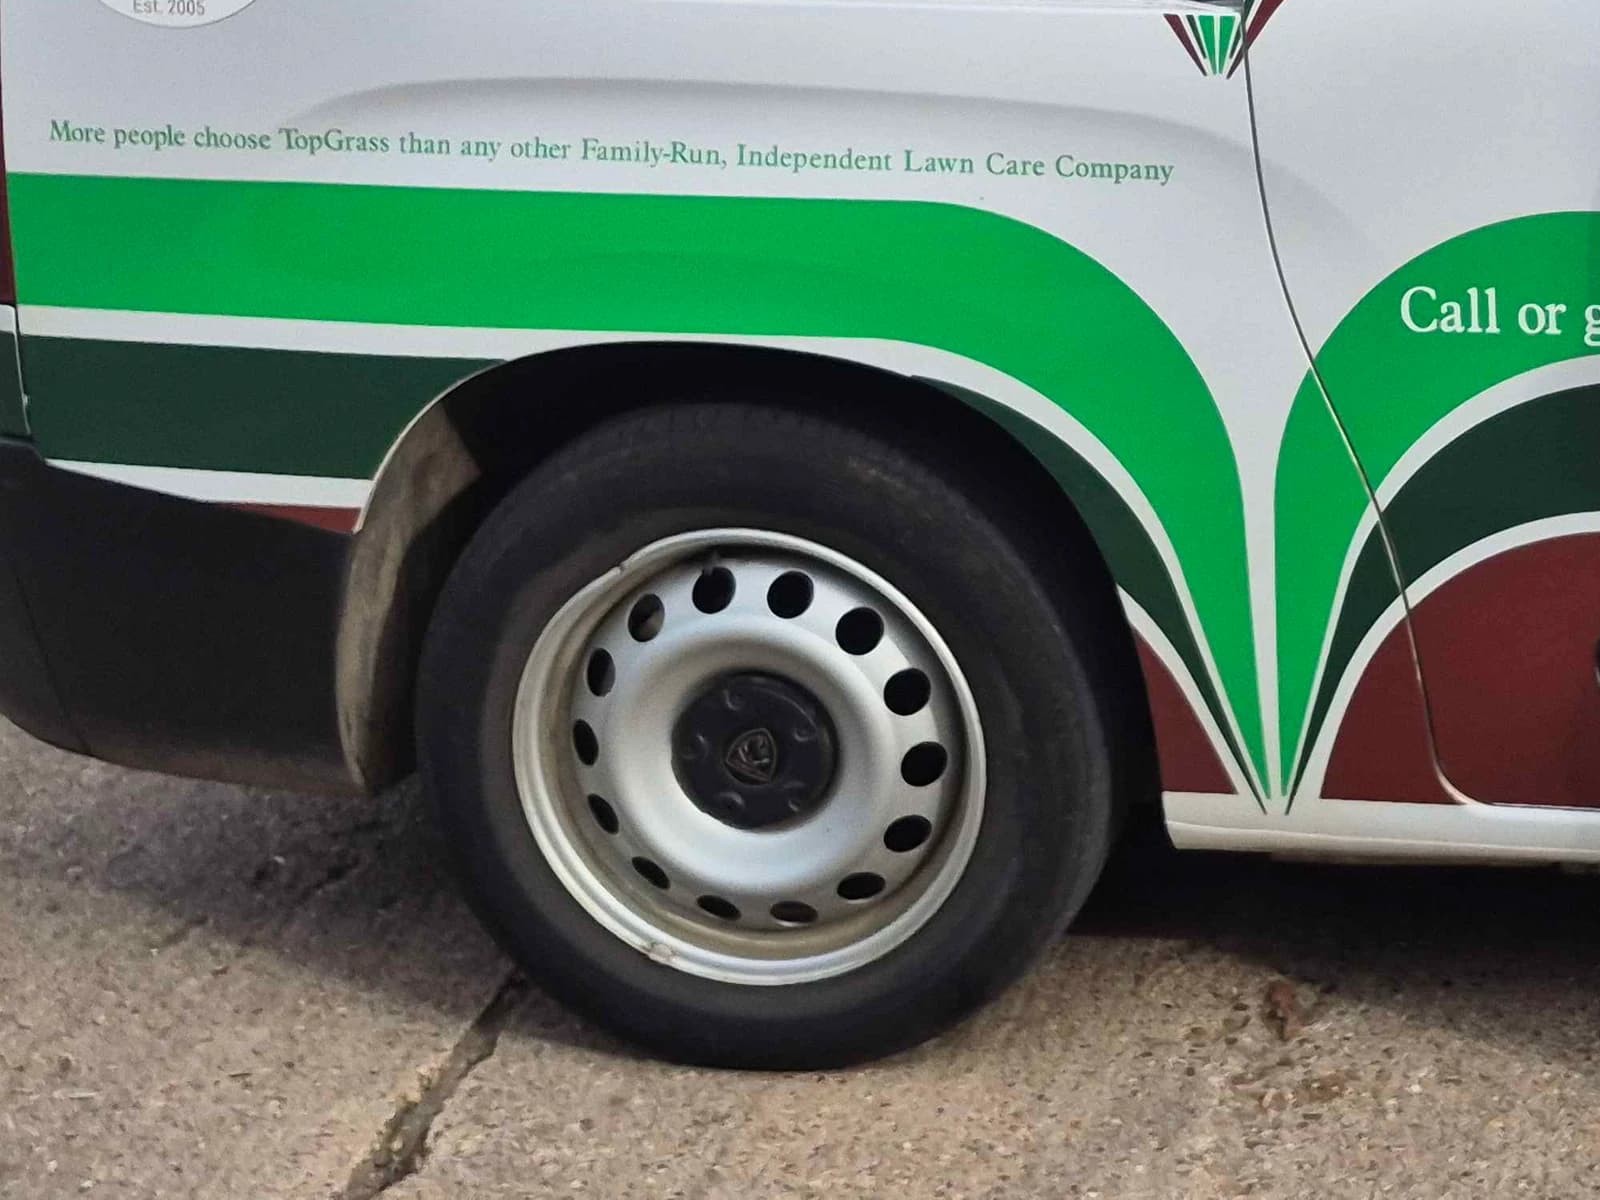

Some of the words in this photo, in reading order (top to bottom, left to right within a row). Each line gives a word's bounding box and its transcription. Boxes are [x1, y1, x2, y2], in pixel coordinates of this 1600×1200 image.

[167, 0, 205, 17] 2005
[49, 120, 105, 145] More
[112, 124, 186, 153] people
[193, 127, 271, 150] choose
[278, 128, 390, 156] TopGrass
[400, 132, 451, 155] than
[460, 140, 501, 162] any
[510, 137, 572, 160] other
[581, 138, 728, 169] Family-Run,
[736, 143, 893, 174] Independent
[904, 149, 975, 175] Lawn
[986, 152, 1046, 178] Care
[1055, 155, 1176, 185] Company
[1400, 286, 1500, 334] Call
[1518, 302, 1567, 334] or
